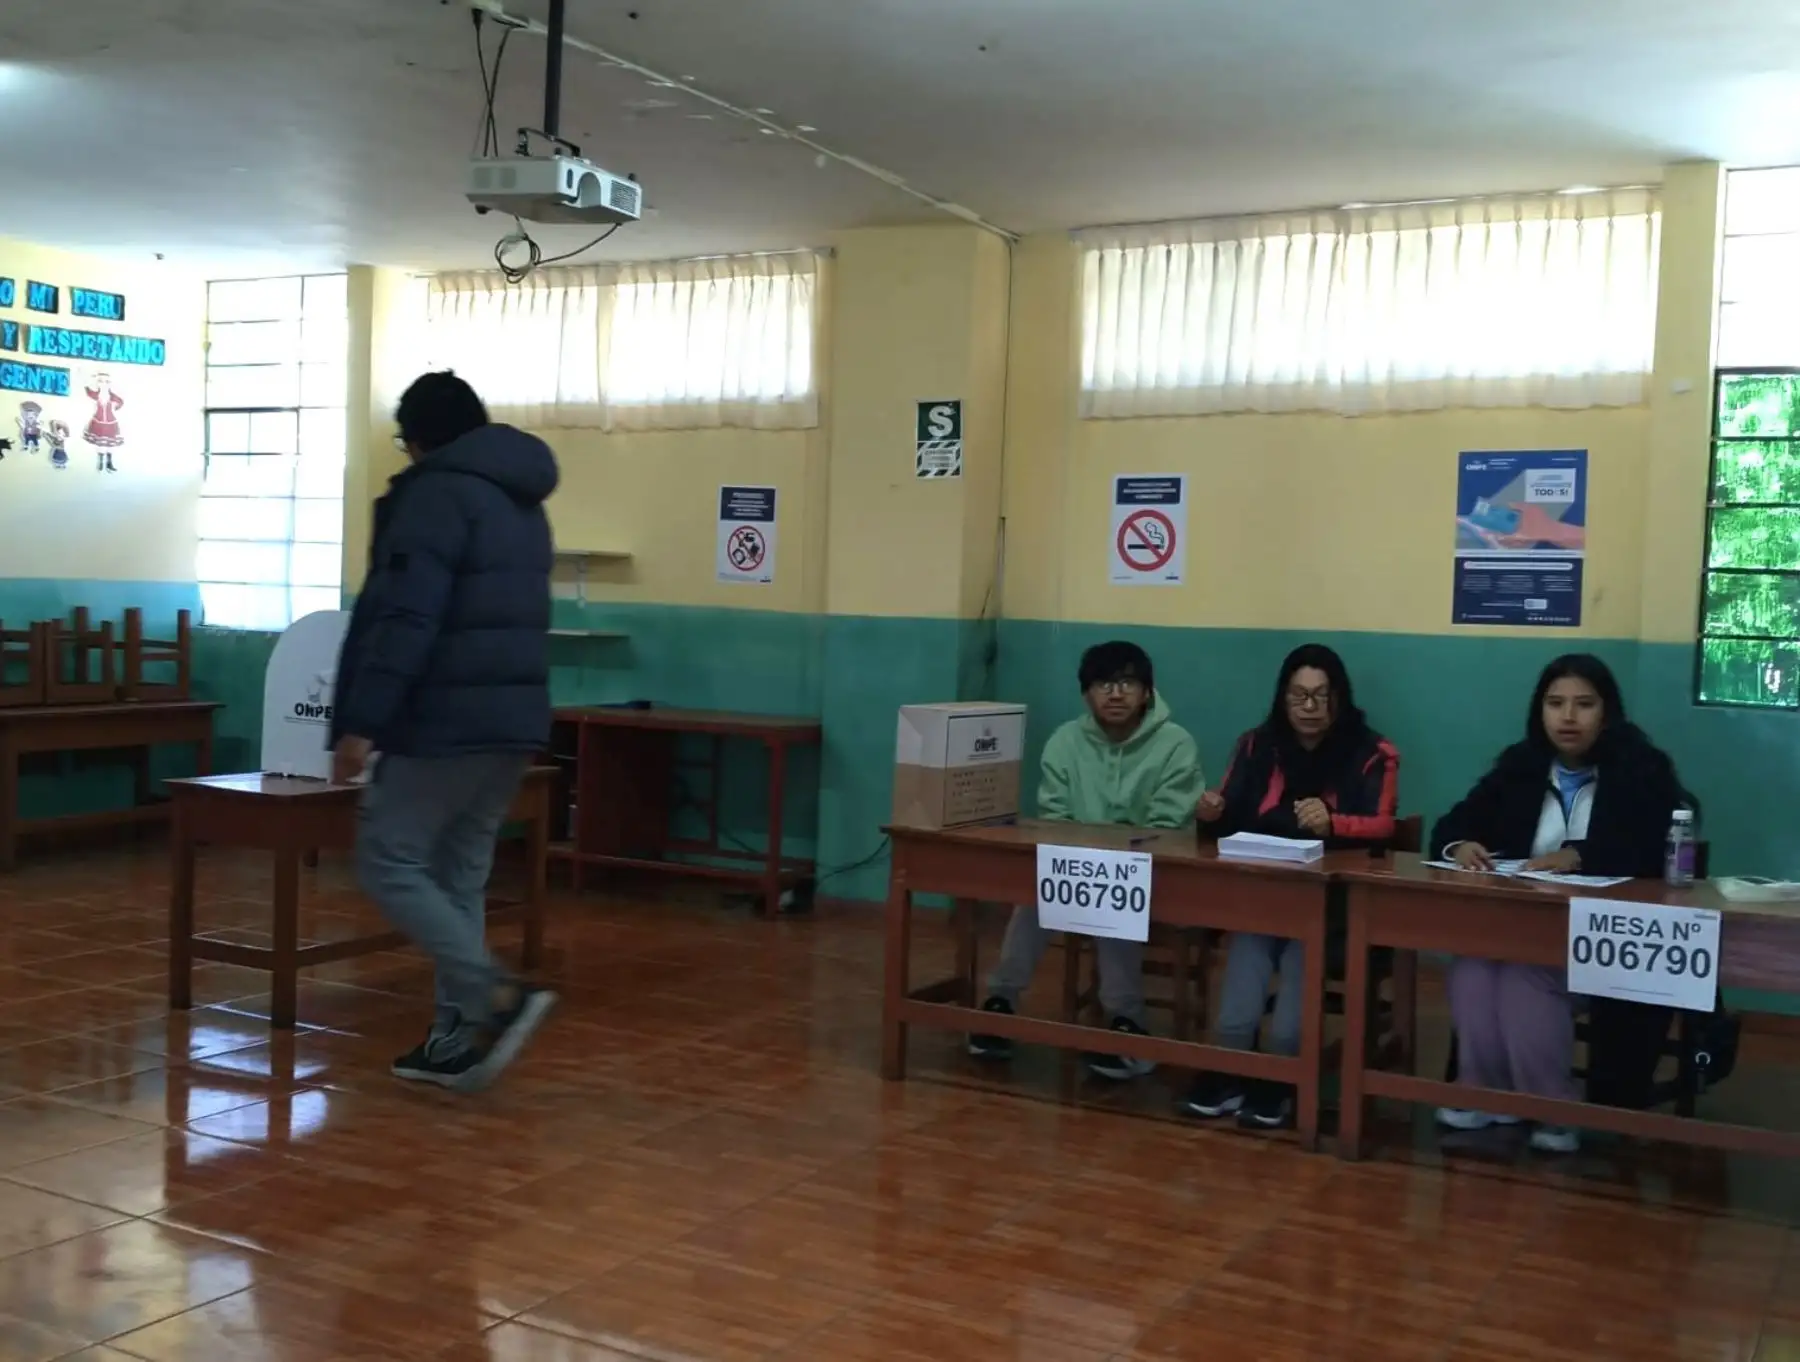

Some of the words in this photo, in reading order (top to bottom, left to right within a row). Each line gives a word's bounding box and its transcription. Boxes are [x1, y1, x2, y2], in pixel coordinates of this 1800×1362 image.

[30, 283, 55, 311] MI
[3, 322, 16, 347] Y
[29, 325, 165, 364] RESPETANDO
[0, 362, 70, 396] GENTE
[928, 405, 954, 437] S
[294, 702, 333, 720] ONPE
[1052, 857, 1109, 880] MESA
[1040, 877, 1146, 913] 006790
[1589, 912, 1664, 939] MESA
[1572, 935, 1711, 979] 006790
